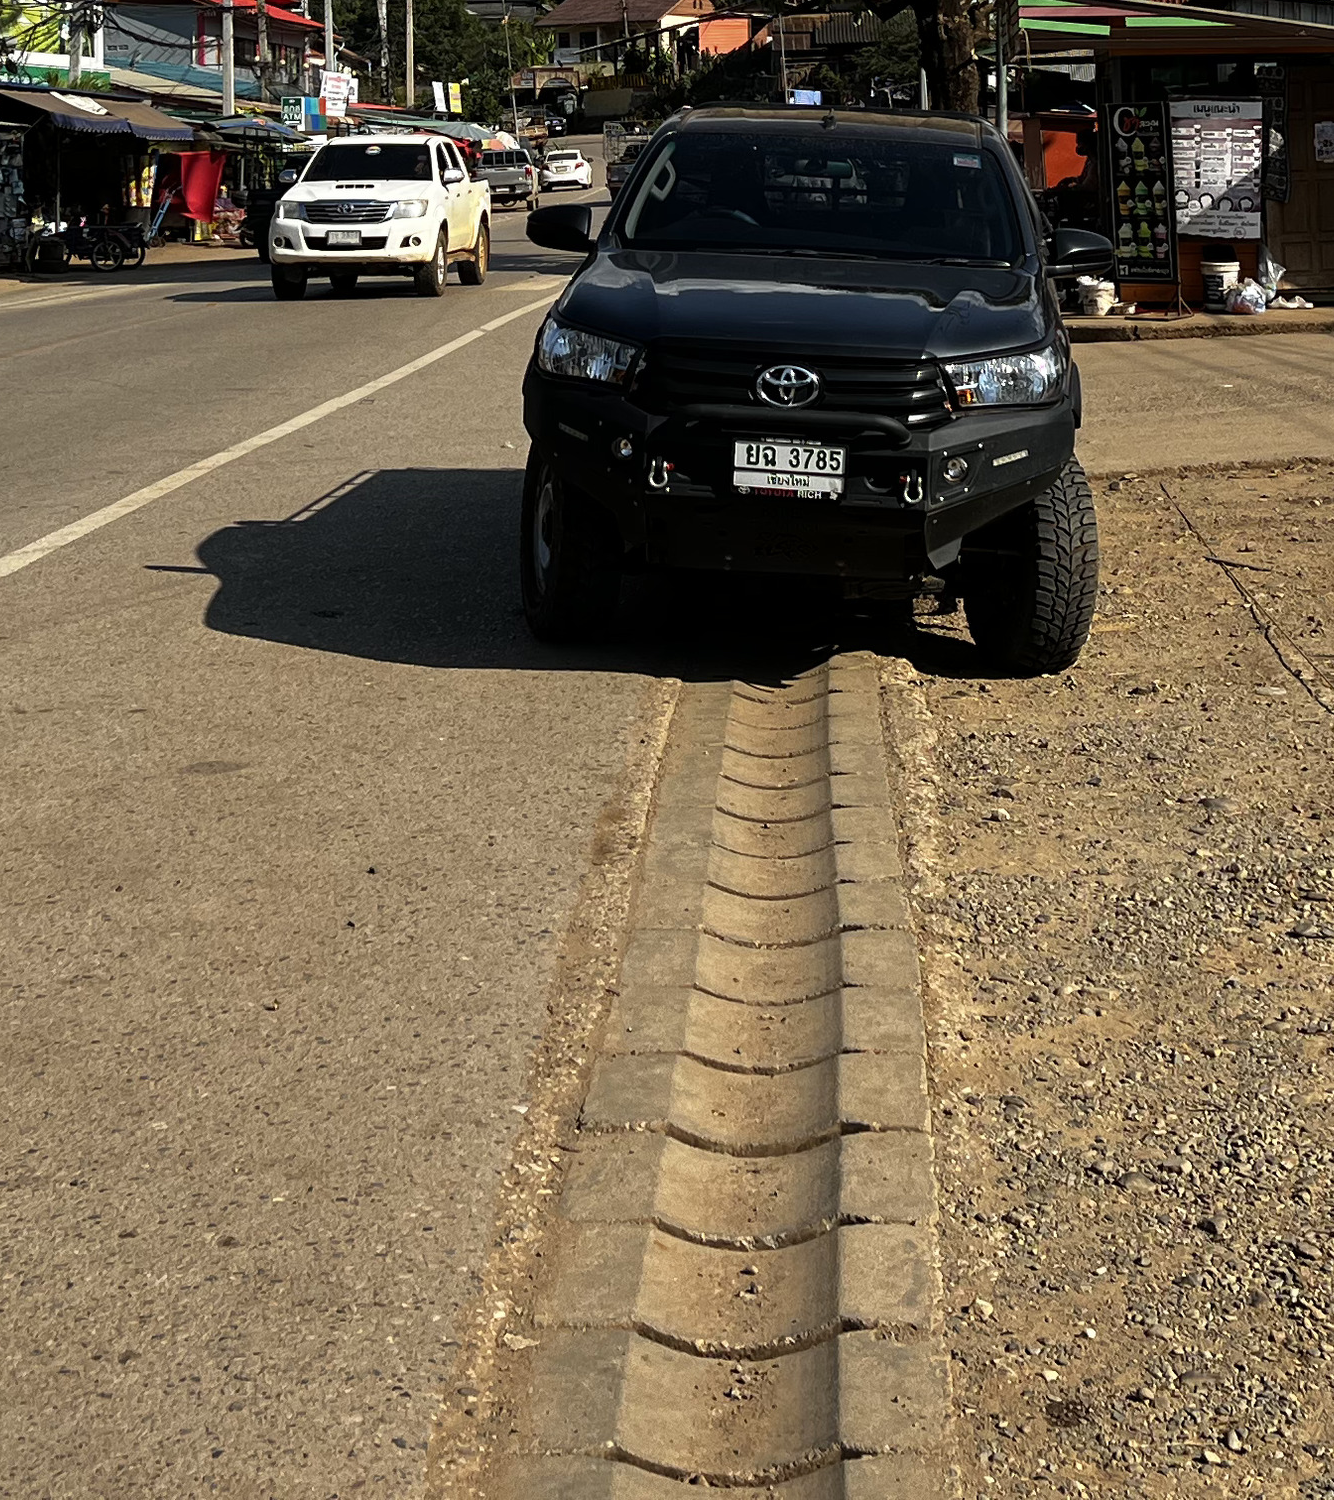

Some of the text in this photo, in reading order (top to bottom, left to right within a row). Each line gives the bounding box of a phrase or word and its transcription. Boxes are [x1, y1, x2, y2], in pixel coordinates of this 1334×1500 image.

[283, 113, 301, 121] ATM
[788, 447, 842, 471] 3785
[767, 473, 810, 487] เชียงใหม่
[797, 490, 822, 499] RICH
